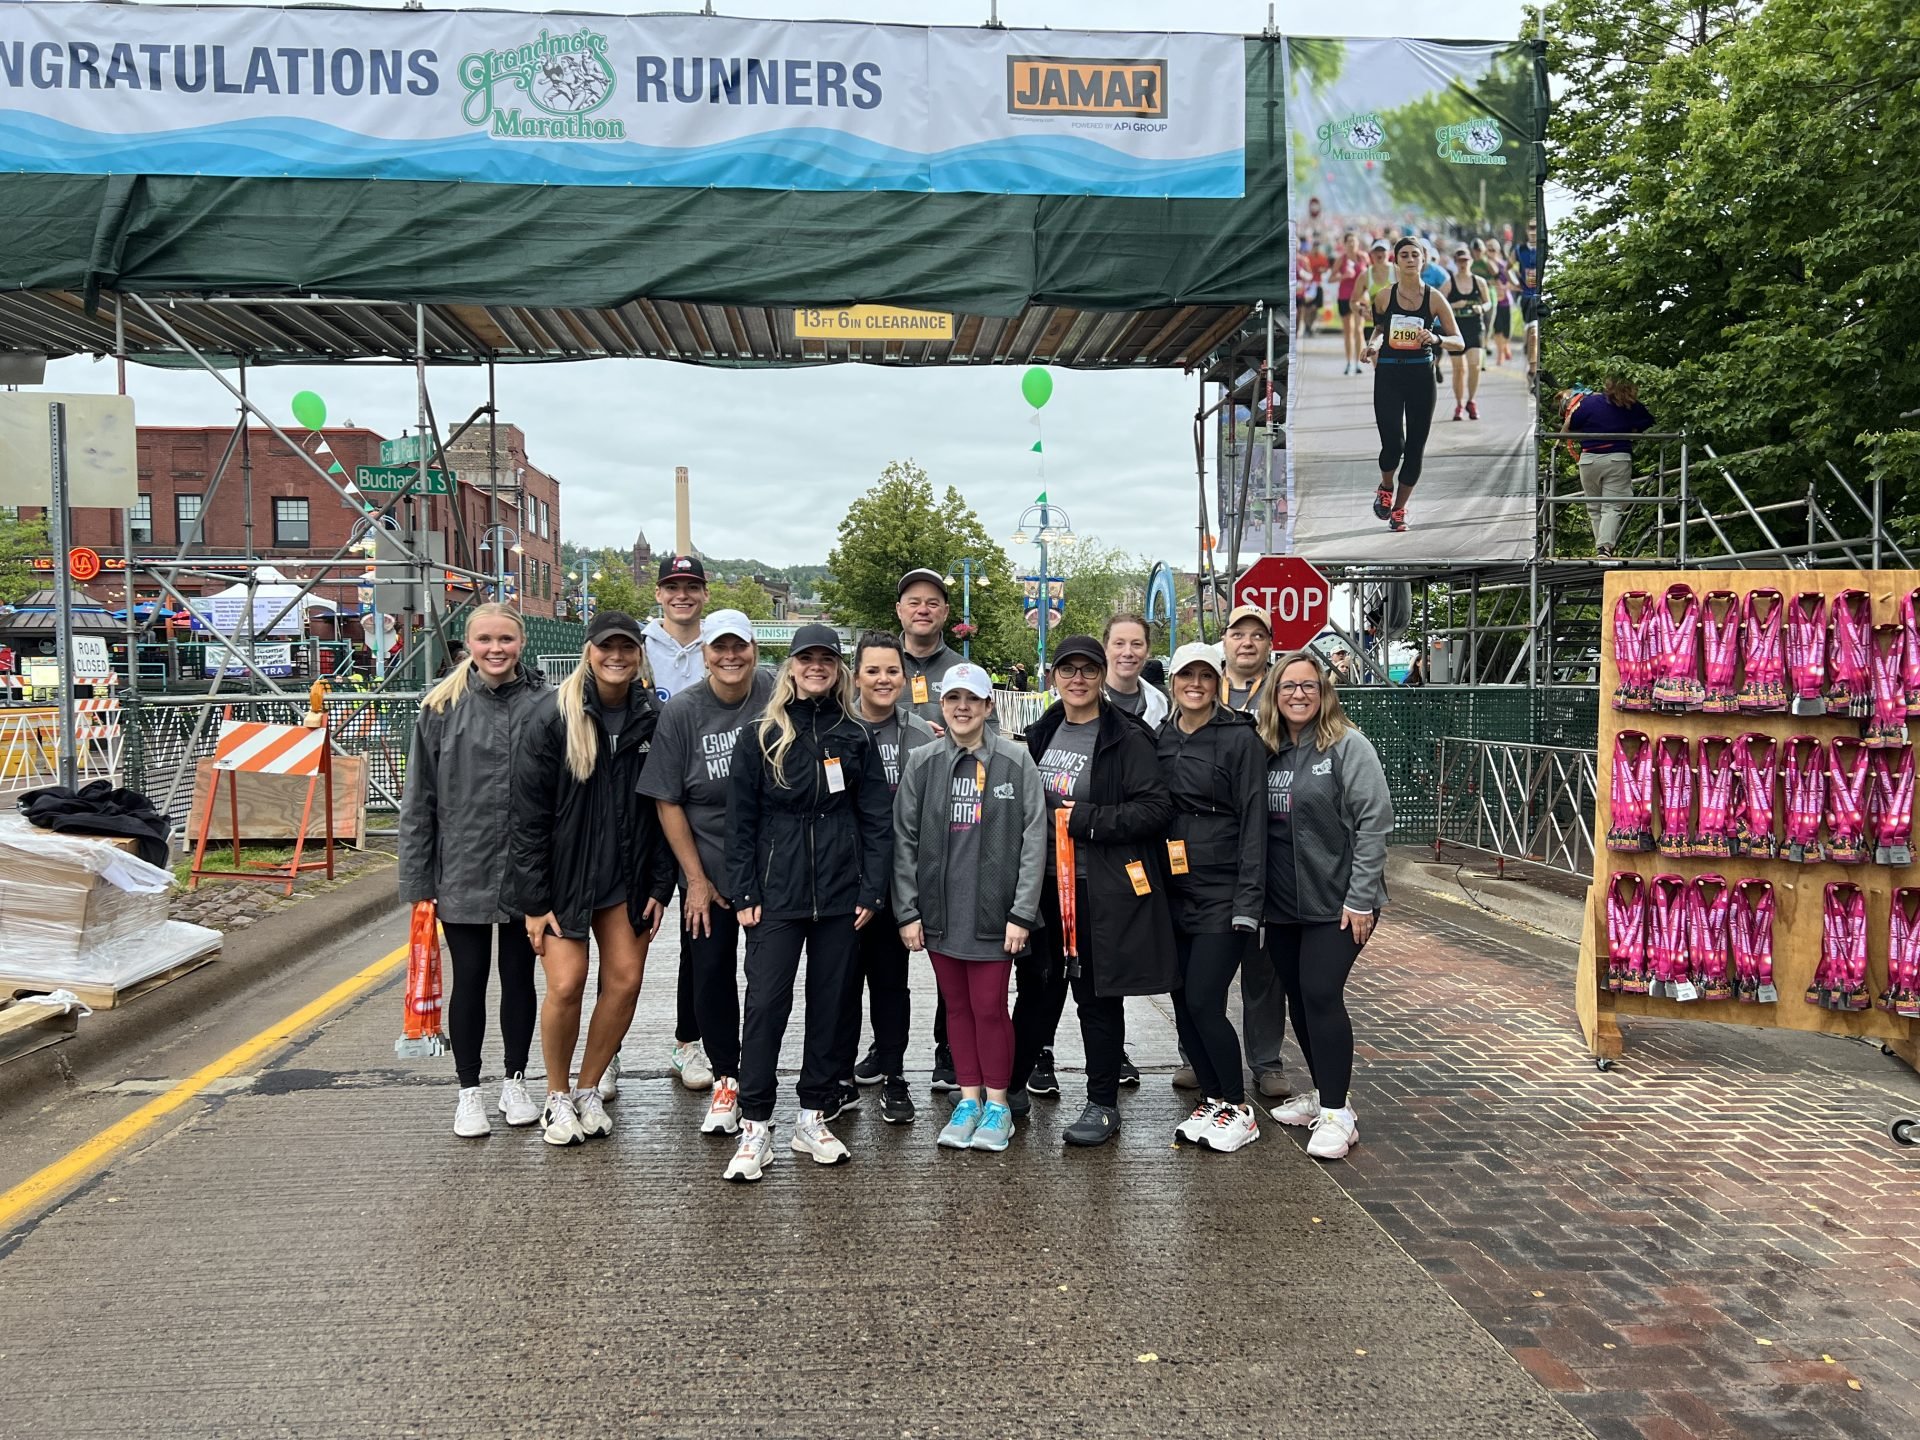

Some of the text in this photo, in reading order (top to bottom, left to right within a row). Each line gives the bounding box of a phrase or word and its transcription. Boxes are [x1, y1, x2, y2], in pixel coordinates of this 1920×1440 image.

[636, 55, 882, 110] RUNNERS
[1016, 67, 1158, 109] JAMAR
[492, 108, 627, 139] Marathon
[1071, 122, 1105, 130] POWERED
[1133, 122, 1168, 132] GROUP
[1332, 148, 1391, 162] Marathon
[1450, 150, 1507, 165] Marathon
[865, 316, 947, 329] CLEARANCE
[1393, 331, 1417, 341] 2190
[1241, 587, 1323, 622] STOP
[756, 629, 789, 638] FINISH
[78, 642, 100, 655] ROAD
[76, 659, 107, 672] CLOSED
[706, 756, 732, 780] MA
